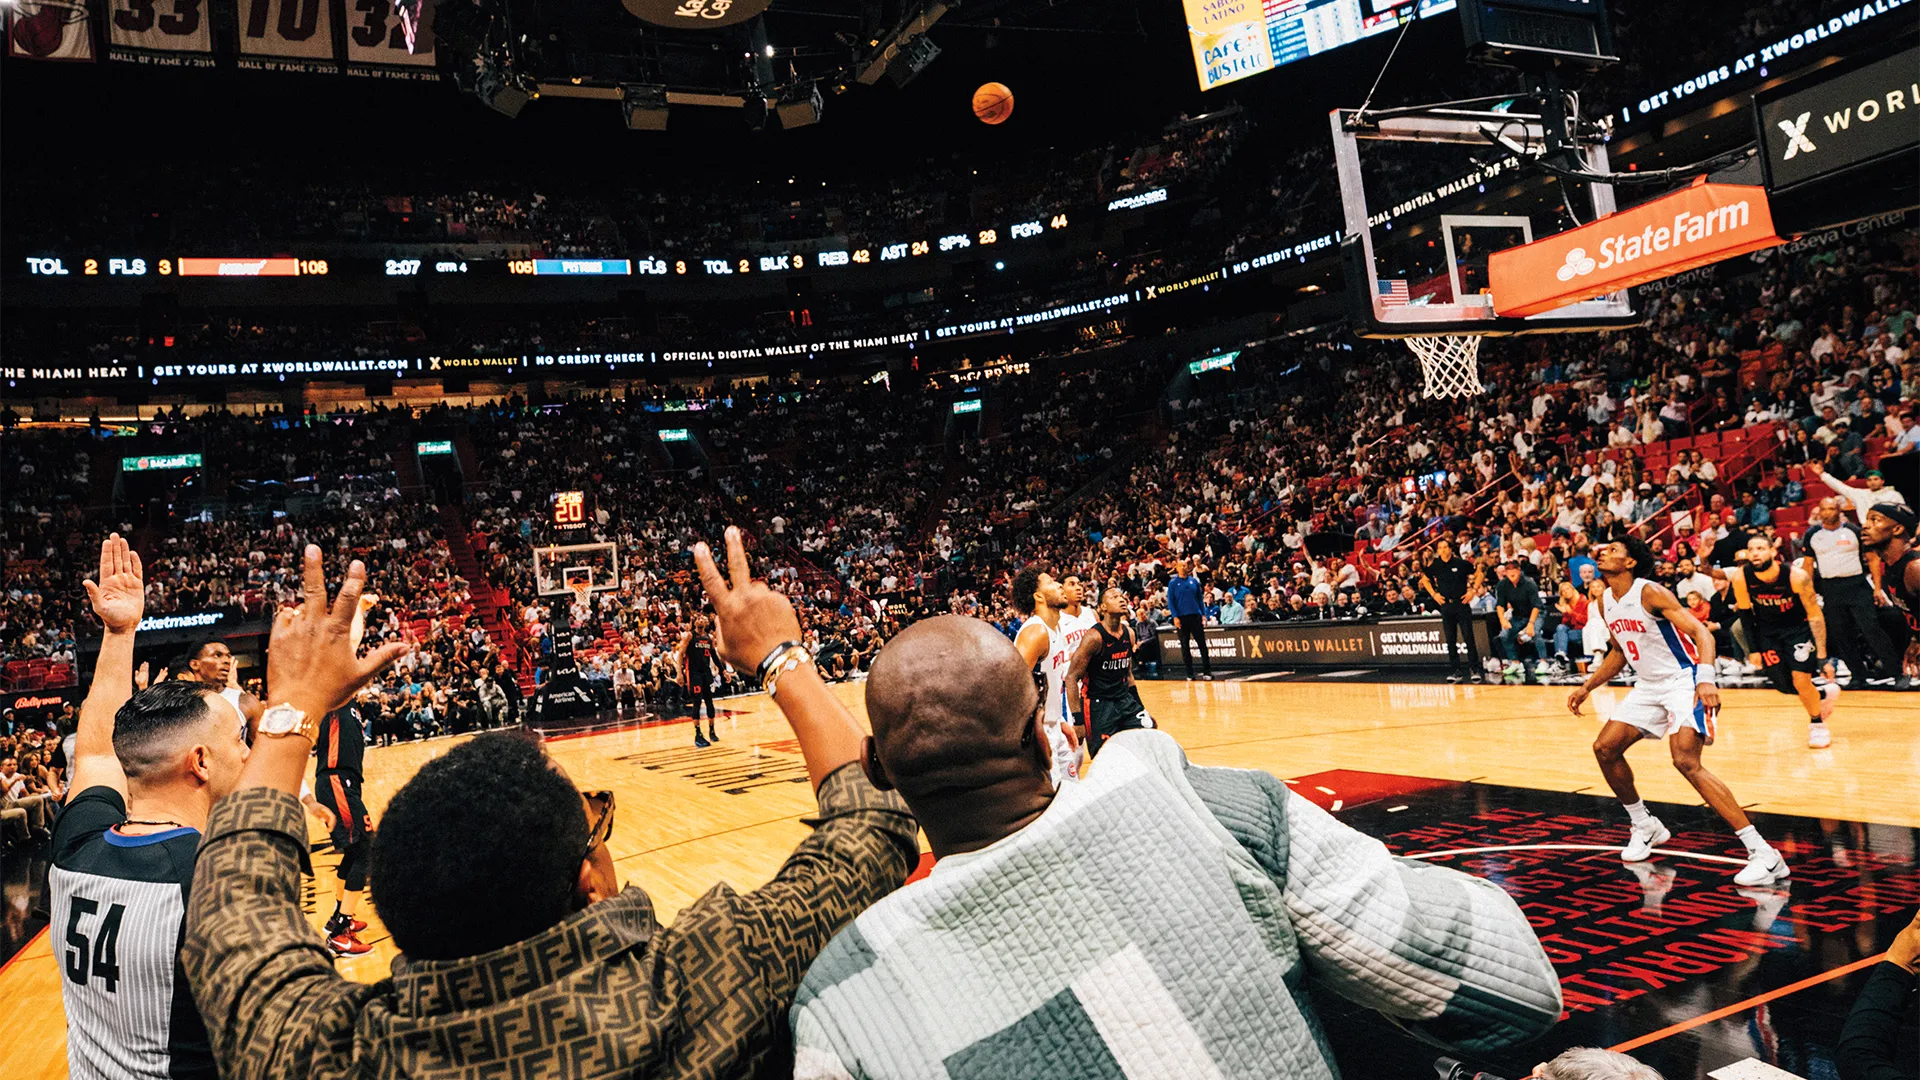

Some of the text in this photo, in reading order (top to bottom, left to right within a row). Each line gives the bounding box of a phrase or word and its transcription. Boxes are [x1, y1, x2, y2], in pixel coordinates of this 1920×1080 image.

[109, 52, 135, 63] HALL
[138, 55, 150, 63] OF
[154, 57, 181, 66] FAME
[238, 60, 263, 70] HALL
[265, 63, 276, 71] OF
[279, 63, 306, 73] FAME
[347, 68, 370, 77] HALL
[372, 70, 383, 78] OF
[385, 71, 410, 79] FAME
[1639, 91, 1668, 113] GET
[1672, 66, 1729, 98] YOURS
[1735, 54, 1755, 74] AT
[1368, 210, 1391, 228] CIAL
[1393, 192, 1436, 218] DIGITAL
[1437, 172, 1482, 199] WALLET
[1842, 208, 1907, 238] Center
[386, 260, 421, 275] 2:07
[459, 262, 467, 272] 4
[507, 261, 531, 275] 105
[639, 257, 667, 274] FLS
[676, 261, 686, 274] 3
[703, 260, 733, 274] TOL
[739, 260, 749, 272] 2
[760, 256, 789, 271] BLK
[793, 255, 803, 268] 3
[818, 251, 849, 266] REB
[852, 250, 870, 263] 42
[881, 243, 908, 260] AST
[912, 241, 929, 255] 24
[979, 230, 996, 244] 28
[1011, 221, 1043, 239] FG%
[1051, 214, 1068, 229] 44
[26, 258, 69, 275] TOL
[85, 259, 98, 274] 2
[109, 259, 146, 275] FLS
[159, 259, 172, 275] 3
[300, 260, 328, 275] 108
[1665, 263, 1717, 288] Center
[32, 369, 81, 378] MIAMI
[89, 367, 127, 377] HEAT
[154, 365, 182, 376] GET
[187, 364, 236, 375] YOURS
[241, 363, 258, 374] AT
[262, 360, 408, 374] XWORLDWALLET.COM
[536, 356, 554, 365] NO
[558, 354, 601, 364] CREDIT
[605, 353, 644, 363] CHECK
[663, 352, 714, 361] OFFICIAL
[718, 349, 762, 359] DIGITAL
[765, 345, 807, 355] WALLET
[811, 343, 825, 351] OF
[829, 341, 849, 350] THE
[854, 337, 887, 347] MIAMI
[892, 333, 918, 344] HEAT
[936, 326, 957, 337] GET
[960, 320, 997, 333] YOURS
[1000, 318, 1013, 327] AT
[1016, 295, 1128, 325] XWORLDWALLET.COM
[1158, 281, 1189, 293] WORLD
[1190, 272, 1218, 285] WALLET
[1233, 262, 1249, 274] NO
[1252, 248, 1291, 268] CREDIT
[1295, 235, 1331, 255] CHECK
[559, 492, 582, 503] 2:06
[555, 504, 582, 522] 20
[563, 522, 587, 530] TISSOT
[136, 613, 218, 631] icketmaster
[1609, 619, 1646, 635] PISTONS
[1164, 640, 1181, 649] OFFIC
[1211, 638, 1235, 648] WALLET
[1264, 639, 1310, 652] WORLD
[1313, 638, 1363, 652] WALLET
[1380, 631, 1440, 643] GET YOURS AT
[1221, 648, 1237, 657] HEAT
[1626, 640, 1640, 661] 9
[1762, 650, 1781, 666] 16
[549, 691, 576, 700] American
[65, 896, 126, 992] 54
